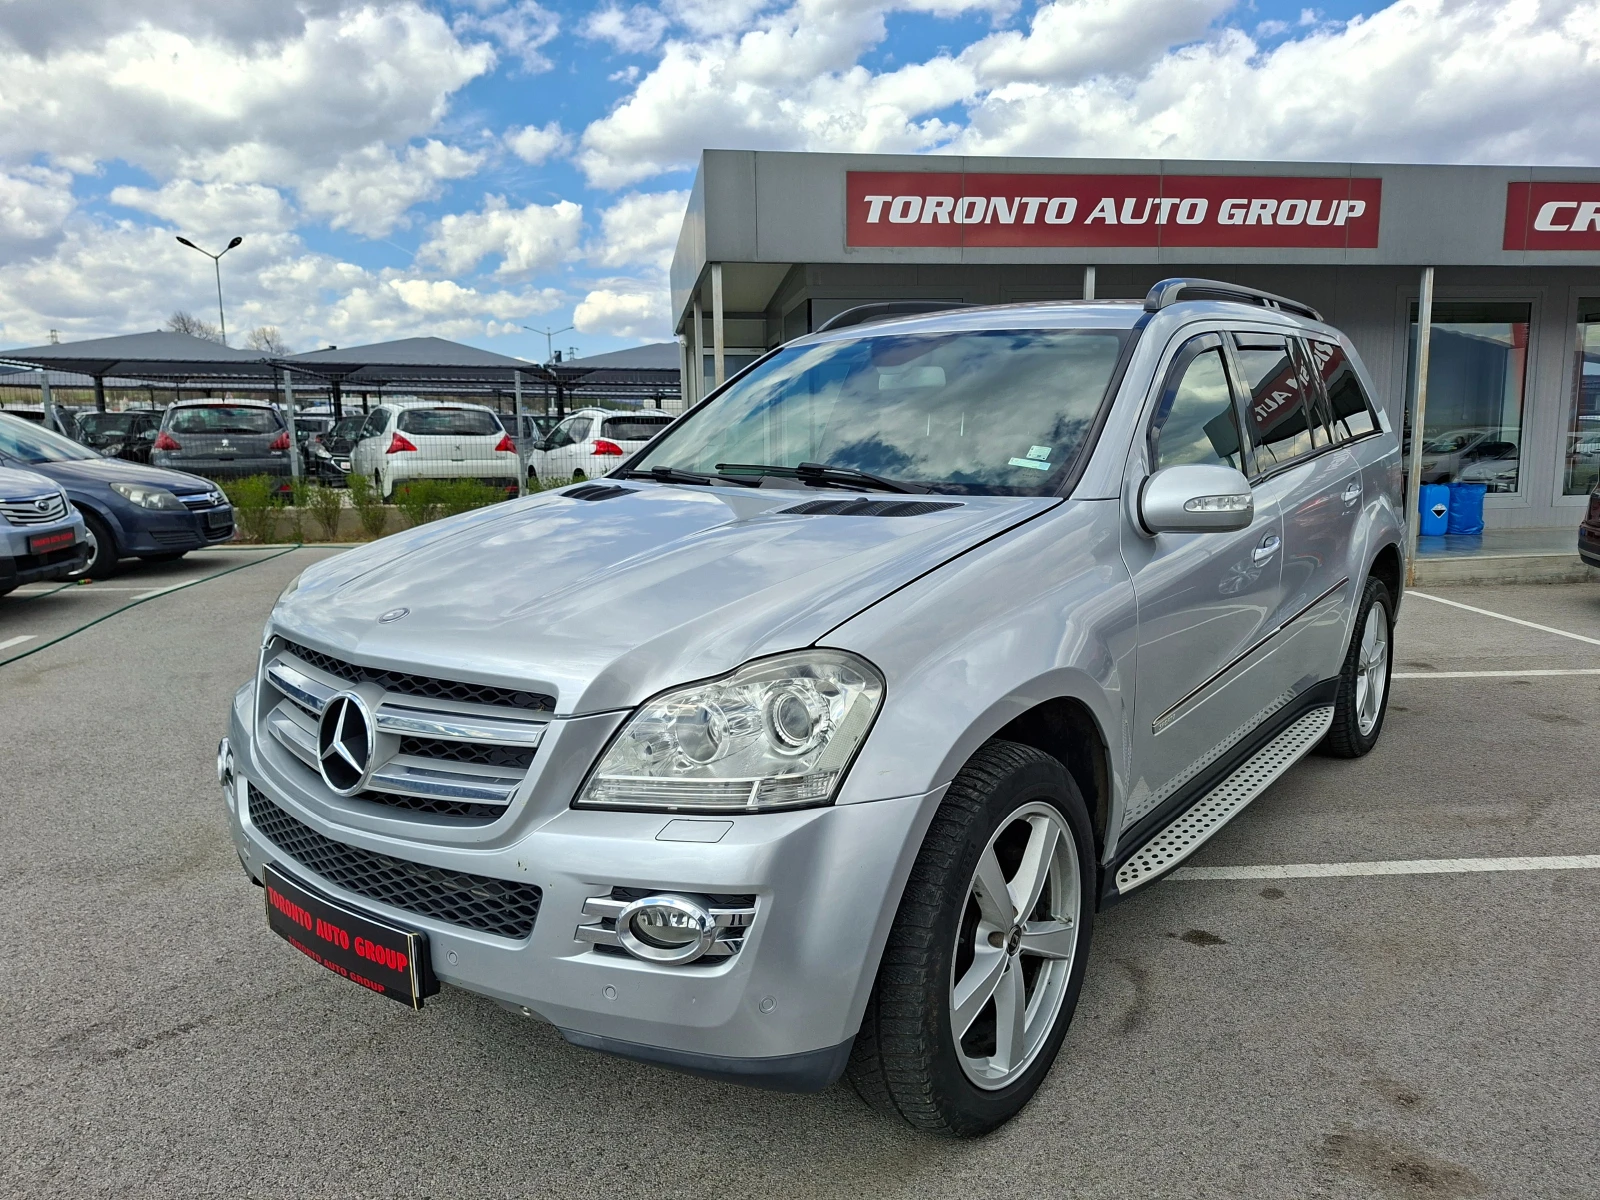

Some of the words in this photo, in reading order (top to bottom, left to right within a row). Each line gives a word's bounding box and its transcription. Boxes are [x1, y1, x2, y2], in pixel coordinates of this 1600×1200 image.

[864, 195, 1078, 224] TORONTO
[1083, 197, 1209, 225] AUTO
[1217, 198, 1366, 226] GROUP
[1534, 201, 1600, 231] CR
[267, 885, 312, 931] TORONTO
[316, 918, 350, 950] AUTO
[354, 936, 408, 973] GROUP
[288, 935, 322, 963] TORONTO
[323, 959, 348, 977] AUTO
[349, 972, 385, 993] GROUP
